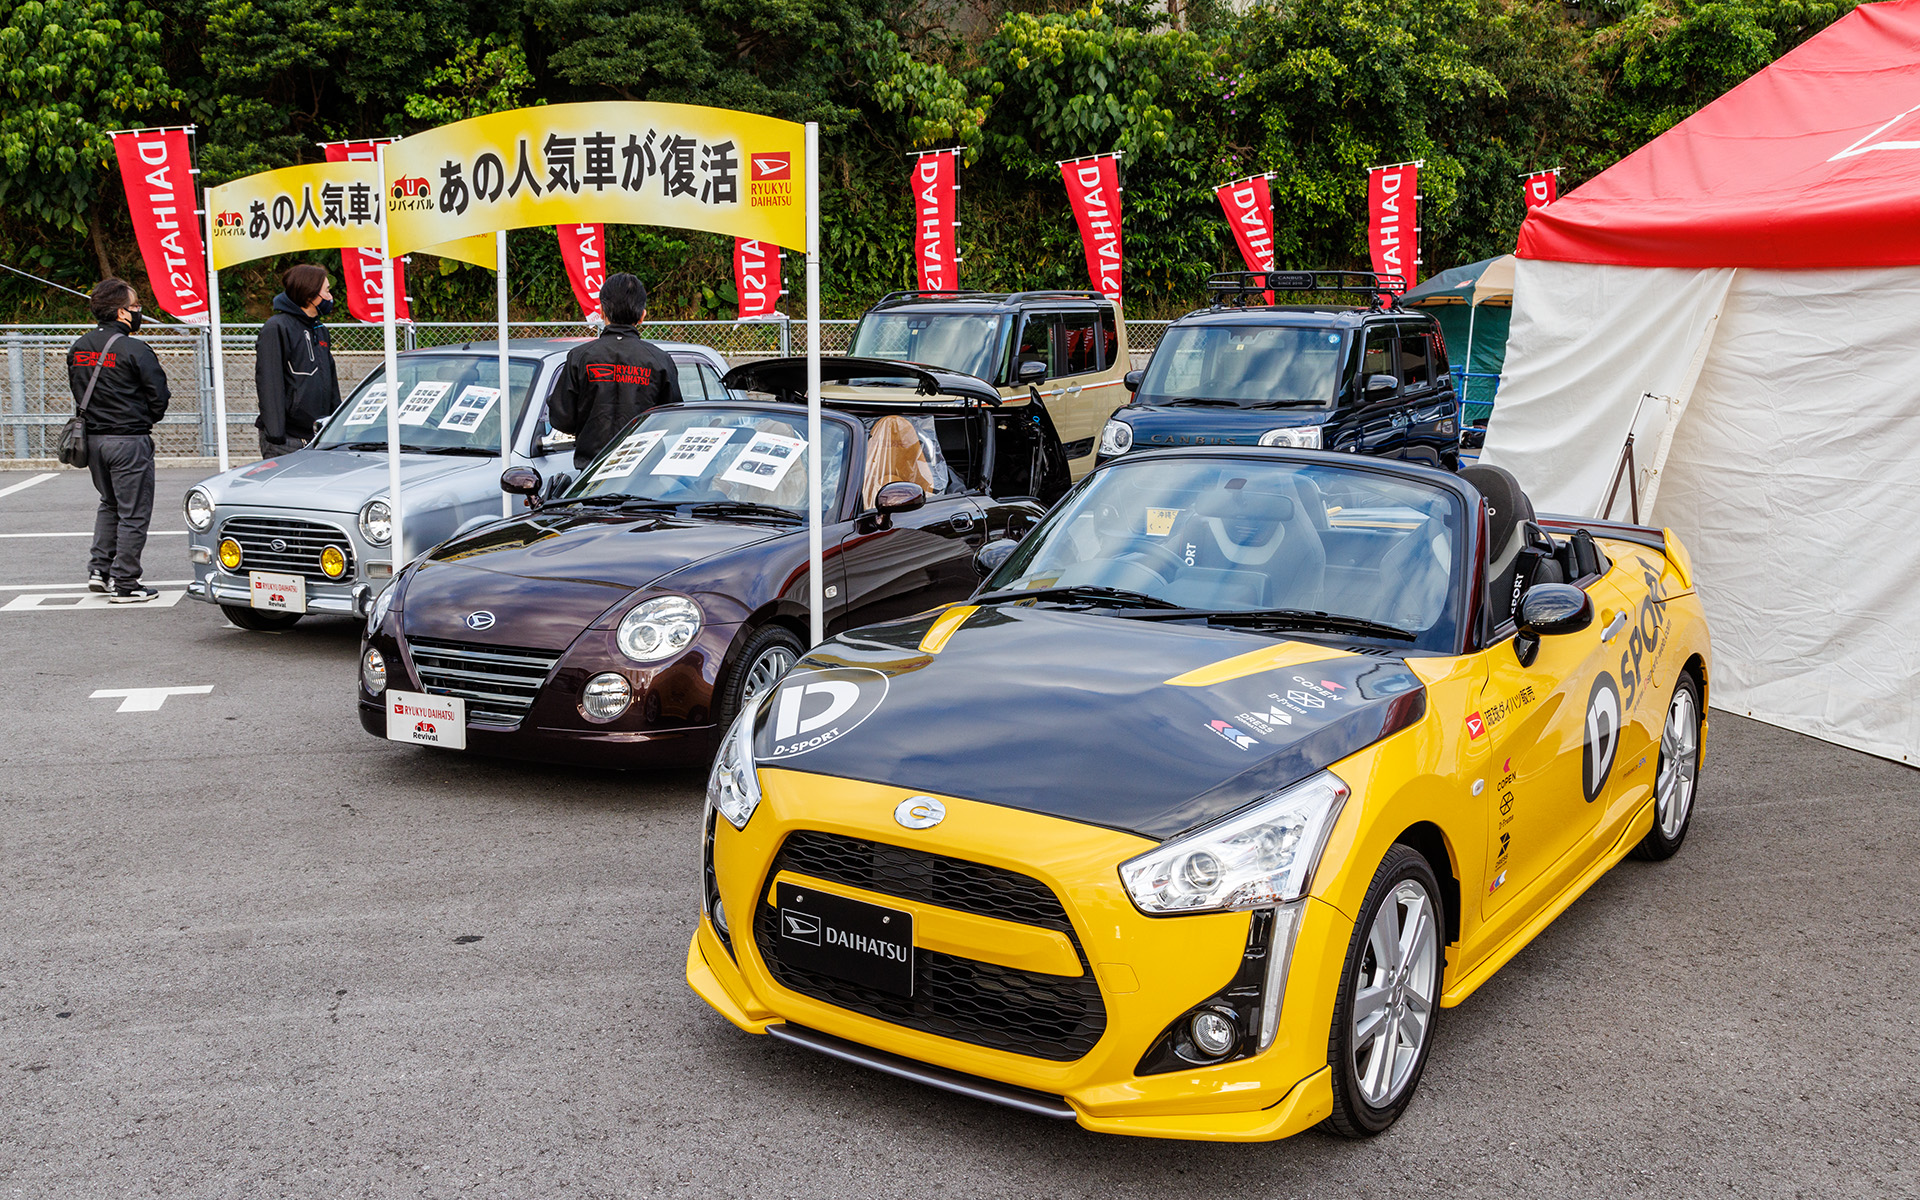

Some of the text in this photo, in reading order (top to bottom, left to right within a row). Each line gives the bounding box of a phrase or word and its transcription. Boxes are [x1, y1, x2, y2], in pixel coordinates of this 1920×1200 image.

[439, 128, 738, 216] あの人気車が復活
[751, 182, 791, 195] RYUKYU
[389, 199, 434, 211] リバイバル
[751, 195, 791, 207] DAIHATSU
[250, 182, 380, 240] あの人気車
[213, 227, 246, 237] リバイバル
[616, 364, 651, 378] RYUKYU
[616, 375, 650, 386] DAIHATSU
[1151, 435, 1236, 445] CANBUS
[1292, 675, 1342, 701] COPEN
[404, 704, 455, 721] RYUKYU DAIHATSU
[1239, 712, 1274, 733] DRESS
[413, 731, 439, 742] Revival
[773, 727, 840, 756] D-SPORT
[1497, 771, 1516, 791] COPEN
[826, 927, 907, 963] DAIHATSU
